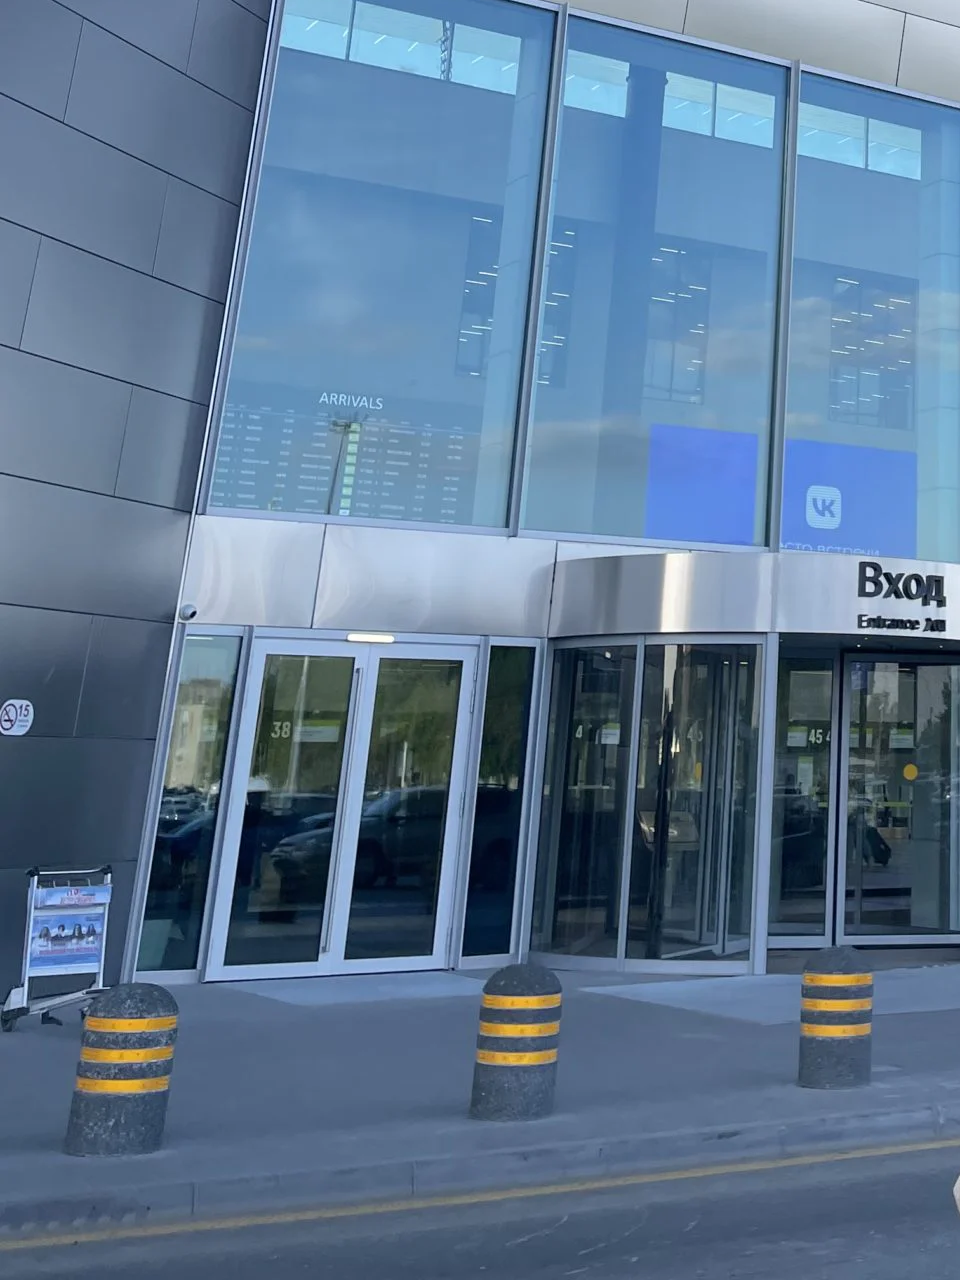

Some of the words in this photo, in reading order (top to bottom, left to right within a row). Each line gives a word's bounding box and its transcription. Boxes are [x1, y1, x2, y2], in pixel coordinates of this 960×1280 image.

[319, 391, 384, 410] ARRIVALS
[858, 561, 947, 608] Вход
[857, 614, 921, 630] Entrance
[18, 704, 30, 717] 15
[271, 721, 291, 739] 38
[808, 729, 823, 744] 45
